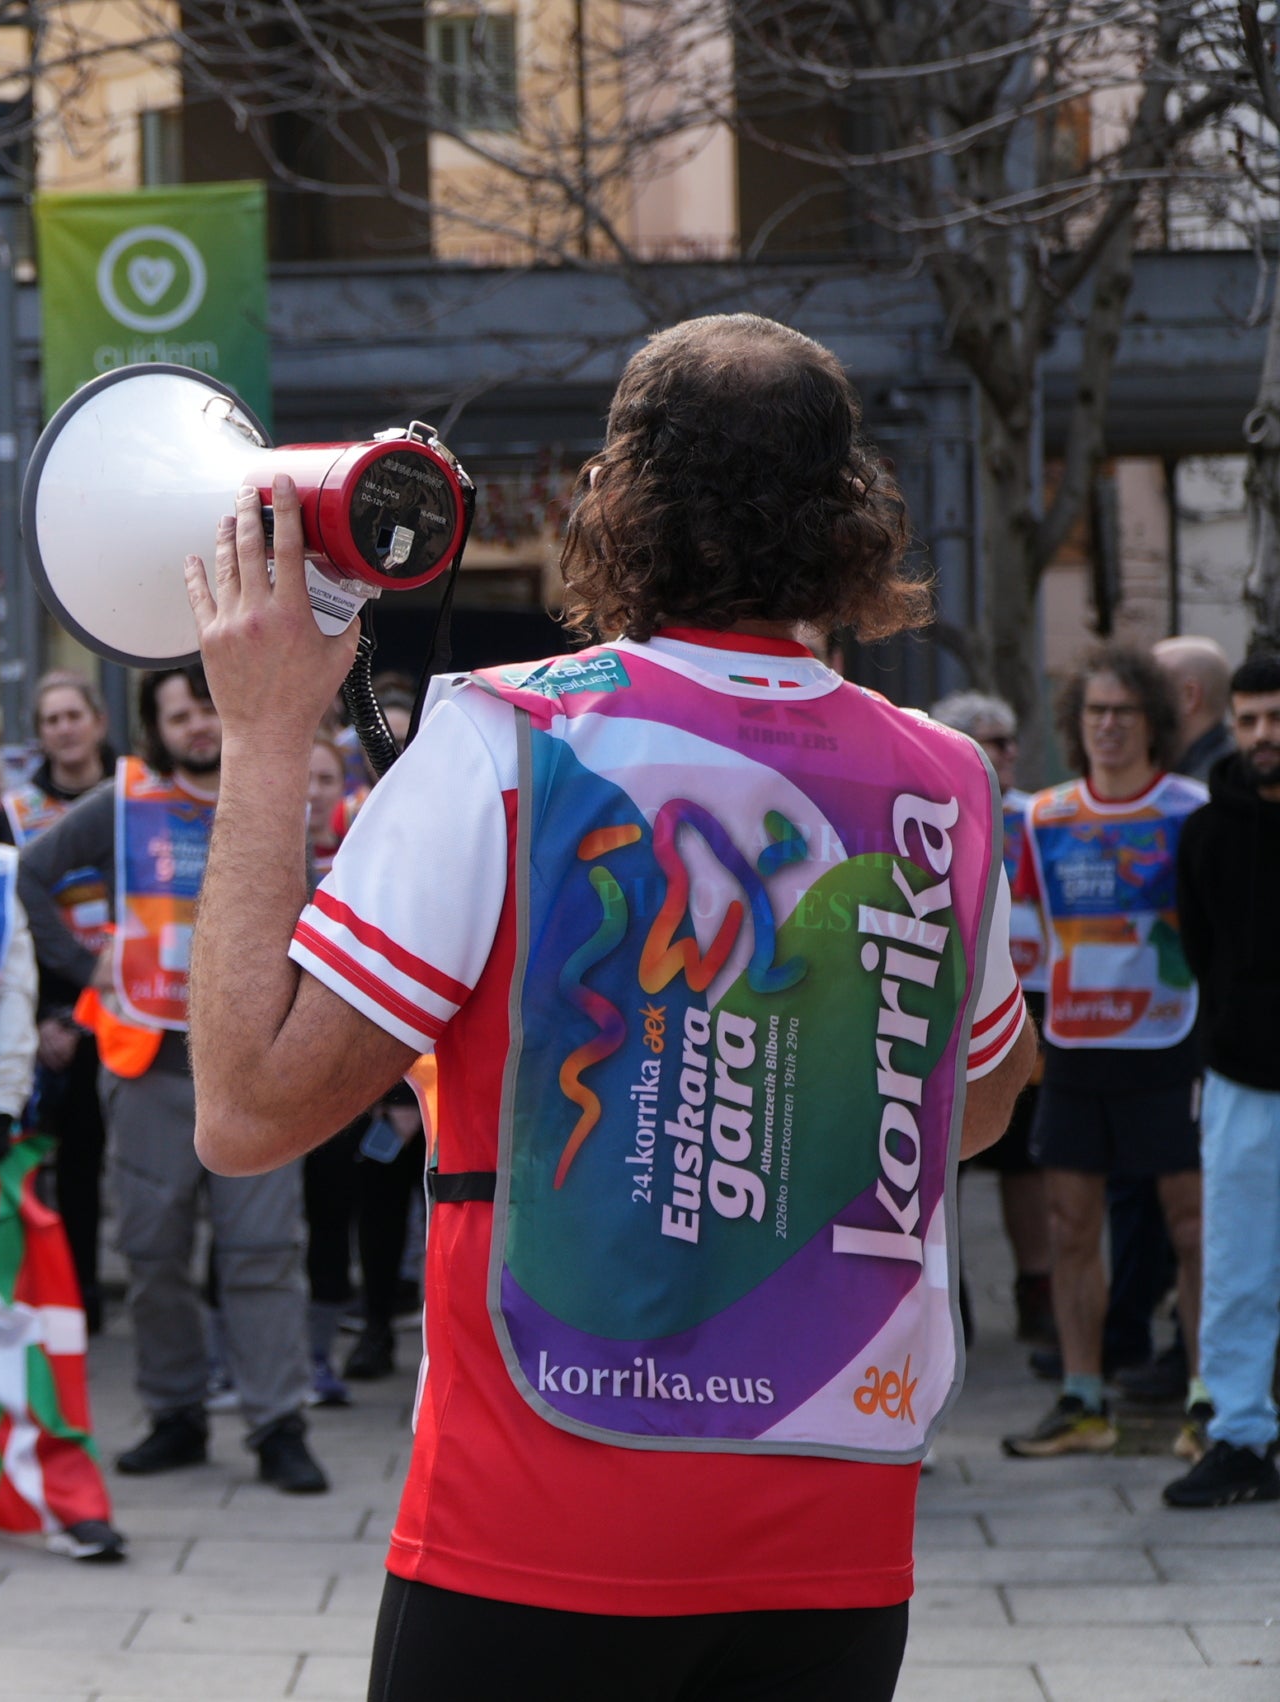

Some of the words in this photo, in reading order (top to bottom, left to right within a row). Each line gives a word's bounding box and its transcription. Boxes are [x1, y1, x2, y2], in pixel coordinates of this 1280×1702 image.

[361, 492, 385, 507] DC-12V
[638, 1002, 667, 1054] aek
[764, 1015, 780, 1071] Bilbora
[786, 1016, 800, 1050] 29ra
[832, 793, 959, 1265] korrika
[784, 1054, 797, 1088] 19tik
[625, 1058, 662, 1204] 24.korrika
[660, 1006, 711, 1245] Euskara
[707, 1010, 767, 1223] gara
[760, 1073, 777, 1175] Atharratzetik
[779, 1094, 795, 1181] martxoaren
[775, 1186, 788, 1240] 2026ko
[537, 1351, 775, 1405] korrika.eus
[852, 1353, 917, 1426] aek
